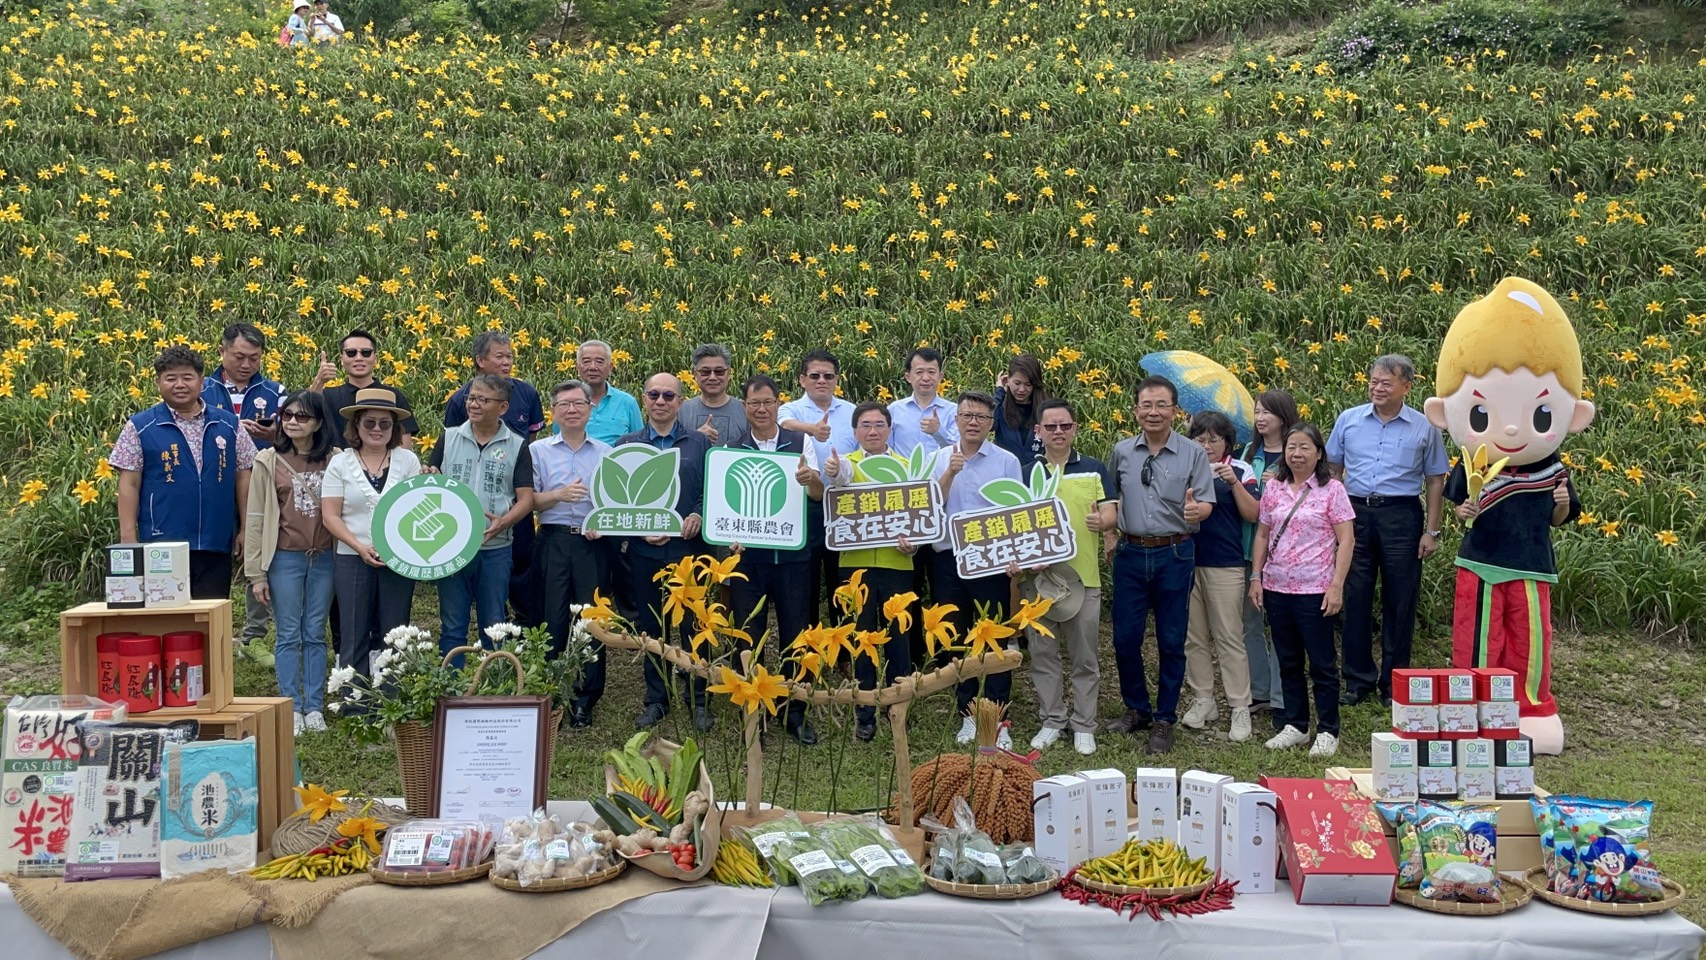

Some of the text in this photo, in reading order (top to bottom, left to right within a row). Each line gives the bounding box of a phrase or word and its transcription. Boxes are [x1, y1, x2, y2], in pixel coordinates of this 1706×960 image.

[403, 475, 459, 489] TAP
[483, 460, 496, 493] 莊瑞雄
[835, 486, 930, 515] 產銷履歷
[597, 511, 671, 530] 在地新鮮
[714, 517, 794, 536] 臺東縣農會
[832, 509, 938, 543] 食在安心
[962, 505, 1058, 543] 產銷履歷
[960, 528, 1069, 572] 食在安心
[386, 555, 467, 579] 產銷履歷農產品
[12, 760, 73, 772] CAS 良質米
[107, 730, 161, 827] 關山
[200, 783, 219, 826] 池農米
